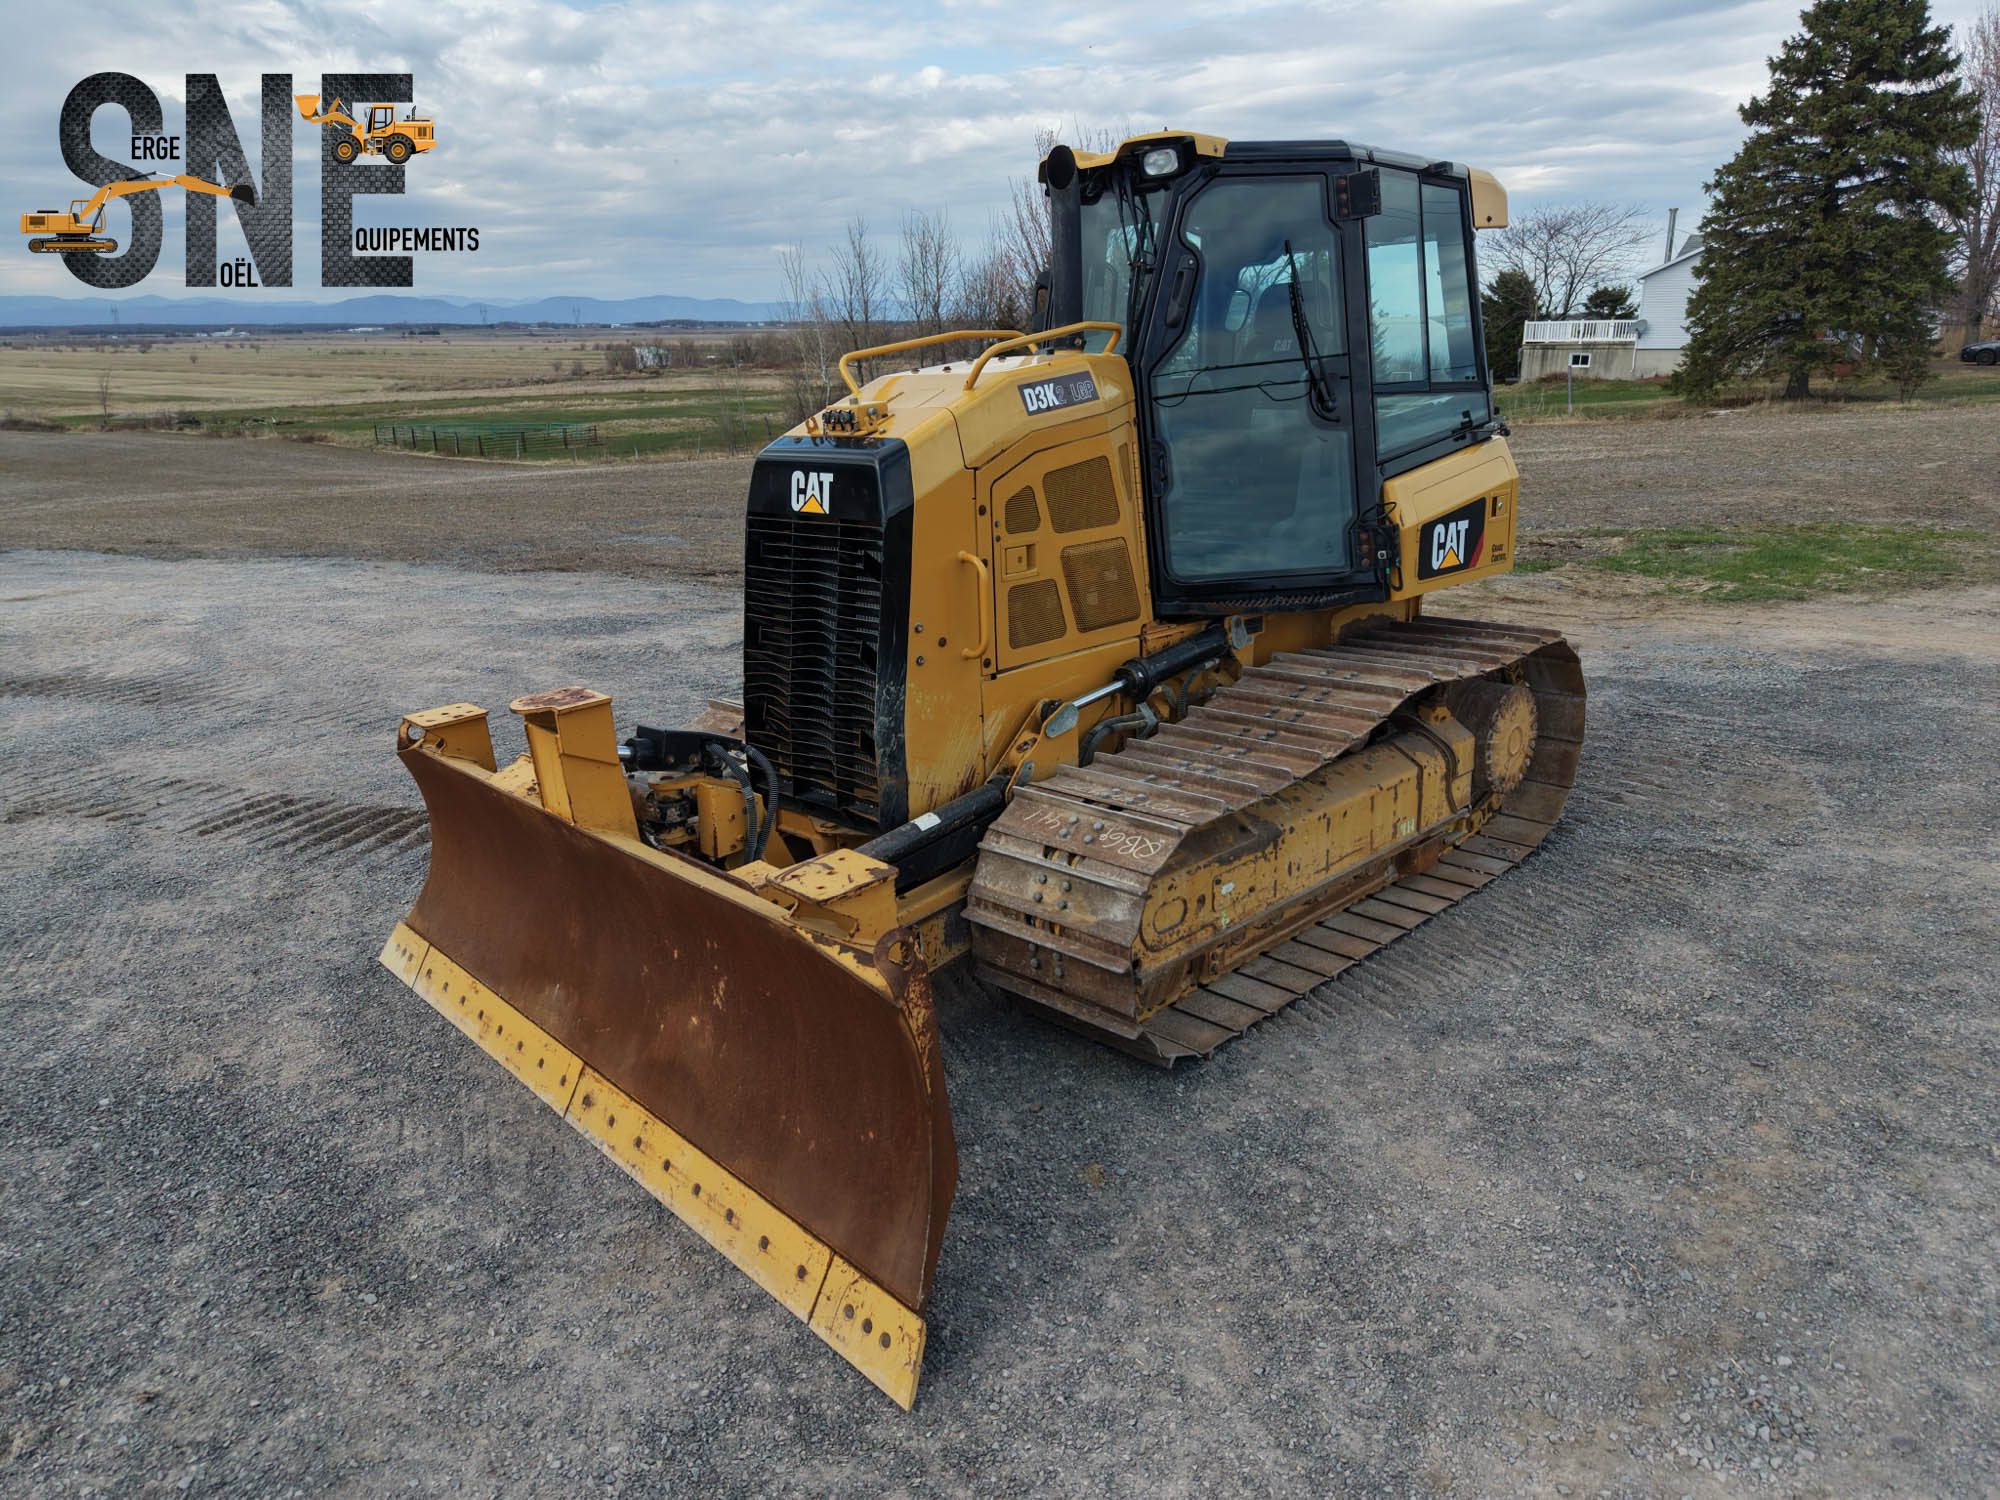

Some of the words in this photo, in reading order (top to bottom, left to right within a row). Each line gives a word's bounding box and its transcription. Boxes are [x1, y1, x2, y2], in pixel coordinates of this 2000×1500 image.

[1070, 380, 1094, 401] LGP
[791, 470, 834, 514] CAT
[1431, 519, 1470, 570] CAT
